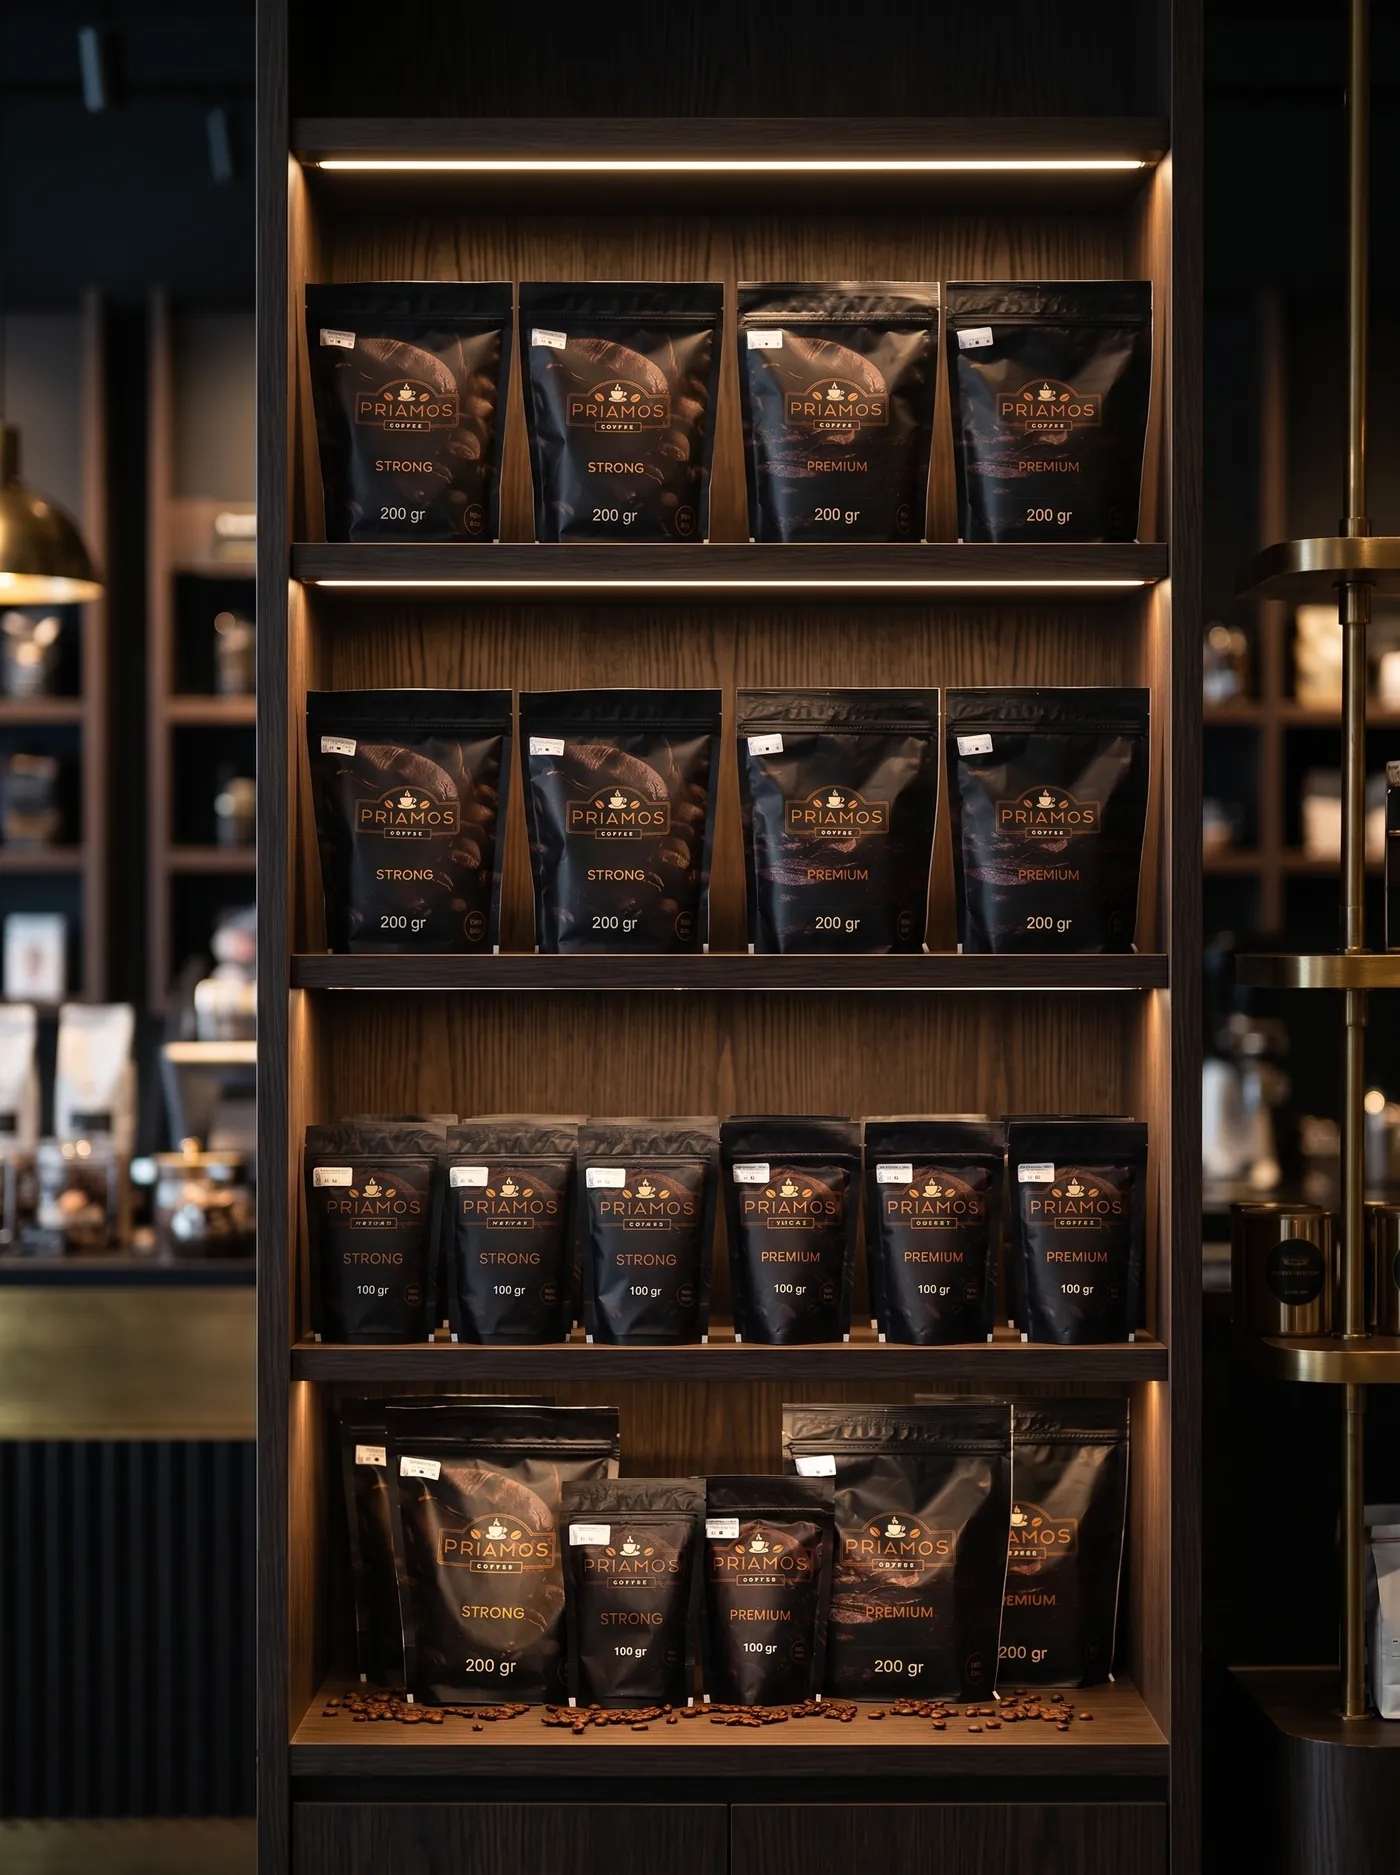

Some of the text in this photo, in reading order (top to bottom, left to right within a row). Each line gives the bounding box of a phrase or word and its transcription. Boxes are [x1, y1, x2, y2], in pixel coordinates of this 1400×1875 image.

[360, 401, 453, 418] PRIAMOS
[572, 403, 664, 419] PRIAMOS
[791, 401, 882, 416] PRIAMOS
[1002, 402, 1095, 417] PRIAMOS
[375, 460, 433, 473] STRONG
[588, 461, 644, 474] STRONG
[807, 461, 868, 472] PREMIUM
[1018, 461, 1080, 472] PREMIUM
[380, 507, 425, 524] 200 gr
[592, 509, 638, 526] 200 gr
[814, 508, 860, 525] 200 gr
[1027, 509, 1072, 525] 200 gr
[361, 810, 454, 825] PRIAMOS
[572, 810, 664, 825] PRIAMOS
[791, 810, 883, 824] PRIAMOS
[1002, 810, 1094, 824] PRIAMOS
[376, 869, 433, 881] STRONG
[587, 869, 644, 881] STRONG
[807, 870, 868, 881] PREMIUM
[1018, 870, 1079, 881] PREMIUM
[380, 915, 426, 933] 200 gr
[592, 916, 638, 933] 200 gr
[815, 917, 860, 933] 200 gr
[1027, 917, 1072, 933] 200 gr
[327, 1200, 421, 1214] PRIAMOS
[463, 1200, 557, 1214] PRIAMOS
[600, 1201, 694, 1215] PRIAMOS
[744, 1201, 836, 1214] PRIAMOS
[888, 1201, 979, 1214] PRIAMOS
[1030, 1201, 1122, 1214] PRIAMOS
[343, 1253, 403, 1265] STRONG
[479, 1253, 540, 1265] STRONG
[616, 1253, 676, 1265] STRONG
[761, 1251, 820, 1263] PREMIUM
[904, 1251, 963, 1263] PREMIUM
[1046, 1251, 1108, 1263] PREMIUM
[356, 1285, 389, 1298] 100 gr
[493, 1285, 525, 1298] 100 gr
[630, 1286, 662, 1298] 100 gr
[774, 1284, 807, 1296] 100 gr
[917, 1285, 950, 1297] 100 gr
[1061, 1284, 1094, 1297] 100 gr
[1010, 1529, 1071, 1544] AMOS
[444, 1538, 549, 1557] PRIAMOS
[845, 1539, 949, 1555] PRIAMOS
[584, 1559, 679, 1573] PRIAMOS
[713, 1556, 808, 1571] PRIAMOS
[1003, 1595, 1056, 1606] EMIUM
[462, 1605, 525, 1619] STRONG
[601, 1612, 663, 1625] STRONG
[730, 1609, 791, 1621] PREMIUM
[865, 1606, 933, 1619] PREMIUM
[614, 1647, 647, 1658] 100 gr
[743, 1643, 777, 1655] 100 gr
[998, 1647, 1047, 1662] 200 gr
[466, 1659, 516, 1676] 200 gr
[874, 1660, 924, 1676] 200 gr
